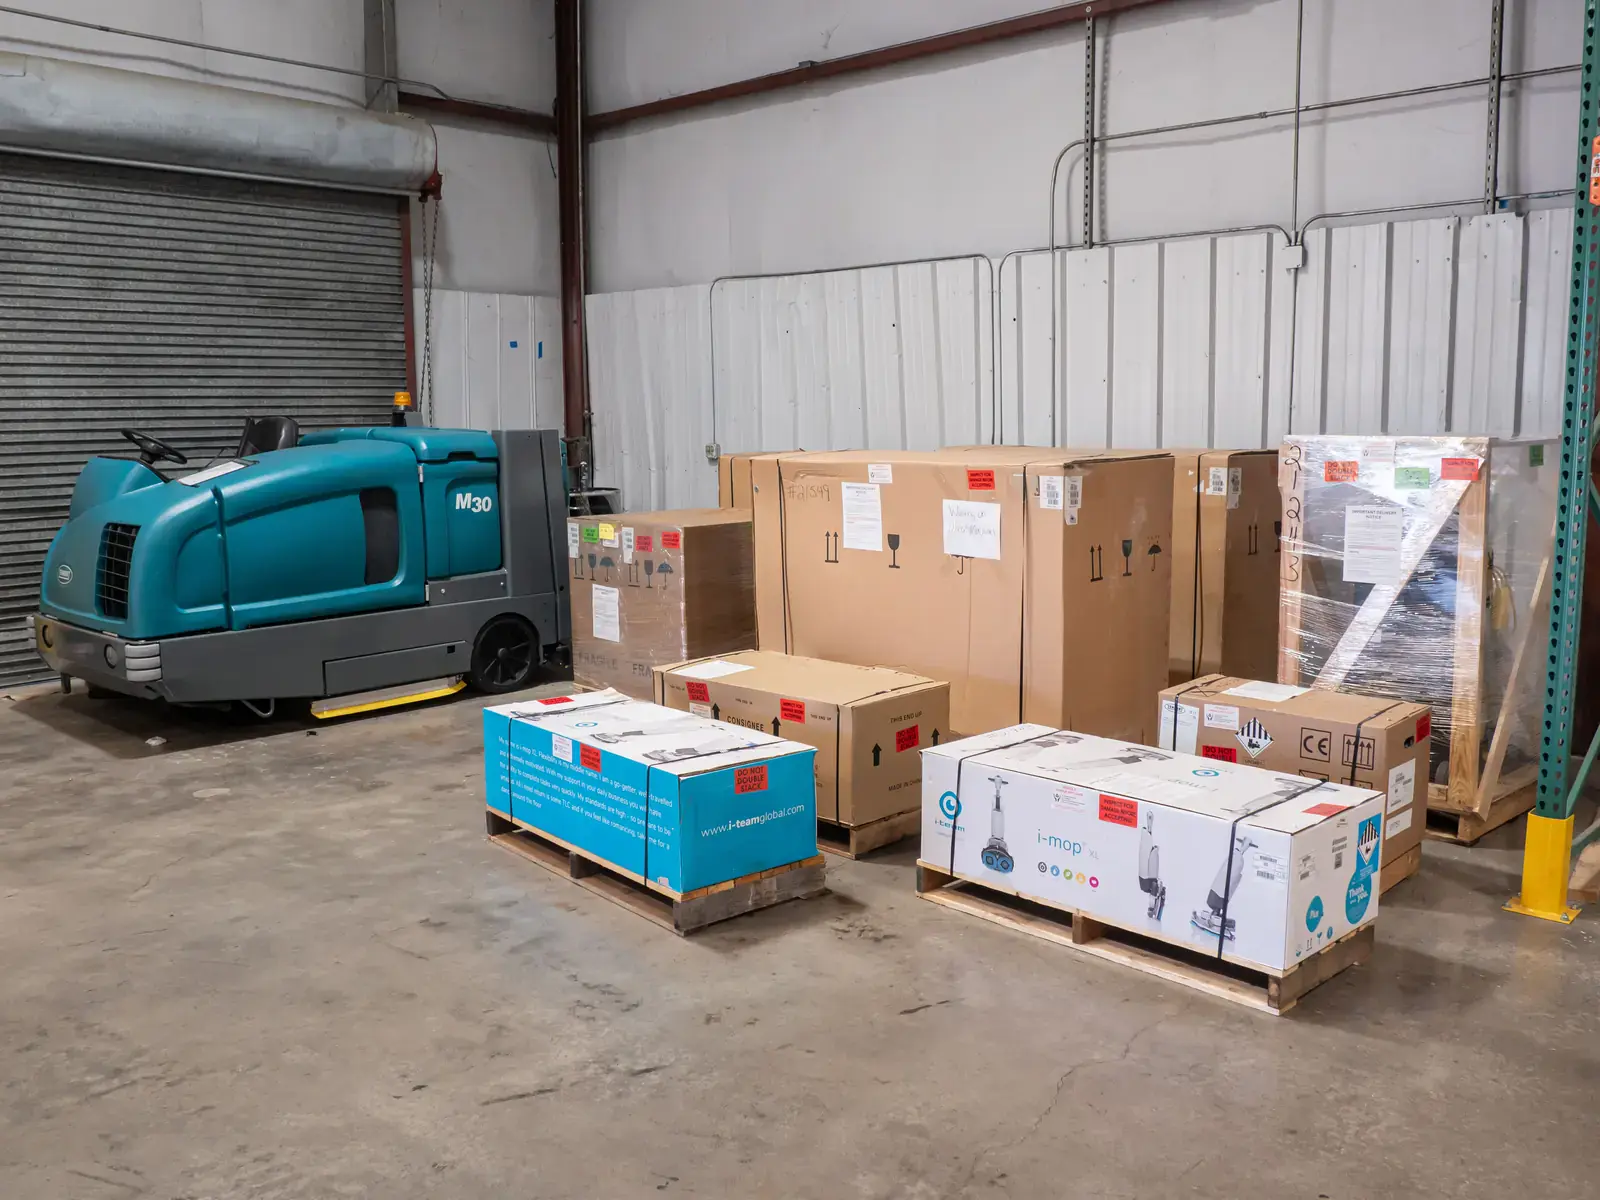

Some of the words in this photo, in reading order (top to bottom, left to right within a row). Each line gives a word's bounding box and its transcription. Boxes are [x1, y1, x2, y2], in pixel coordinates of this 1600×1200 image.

[455, 492, 492, 513] M30
[903, 713, 915, 721] END
[727, 716, 764, 731] CONSIGNEE
[1205, 746, 1217, 754] DO
[1217, 747, 1233, 756] NOT
[1303, 735, 1329, 756] CE
[737, 769, 749, 777] DO
[749, 766, 764, 775] NOT
[737, 774, 764, 785] DOUBLE
[740, 783, 762, 793] STACK
[638, 789, 673, 808] wel-travelled
[701, 804, 805, 837] www.i-teamglobal.com
[657, 825, 664, 834] to
[657, 838, 665, 848] for
[1038, 829, 1082, 856] i-mop
